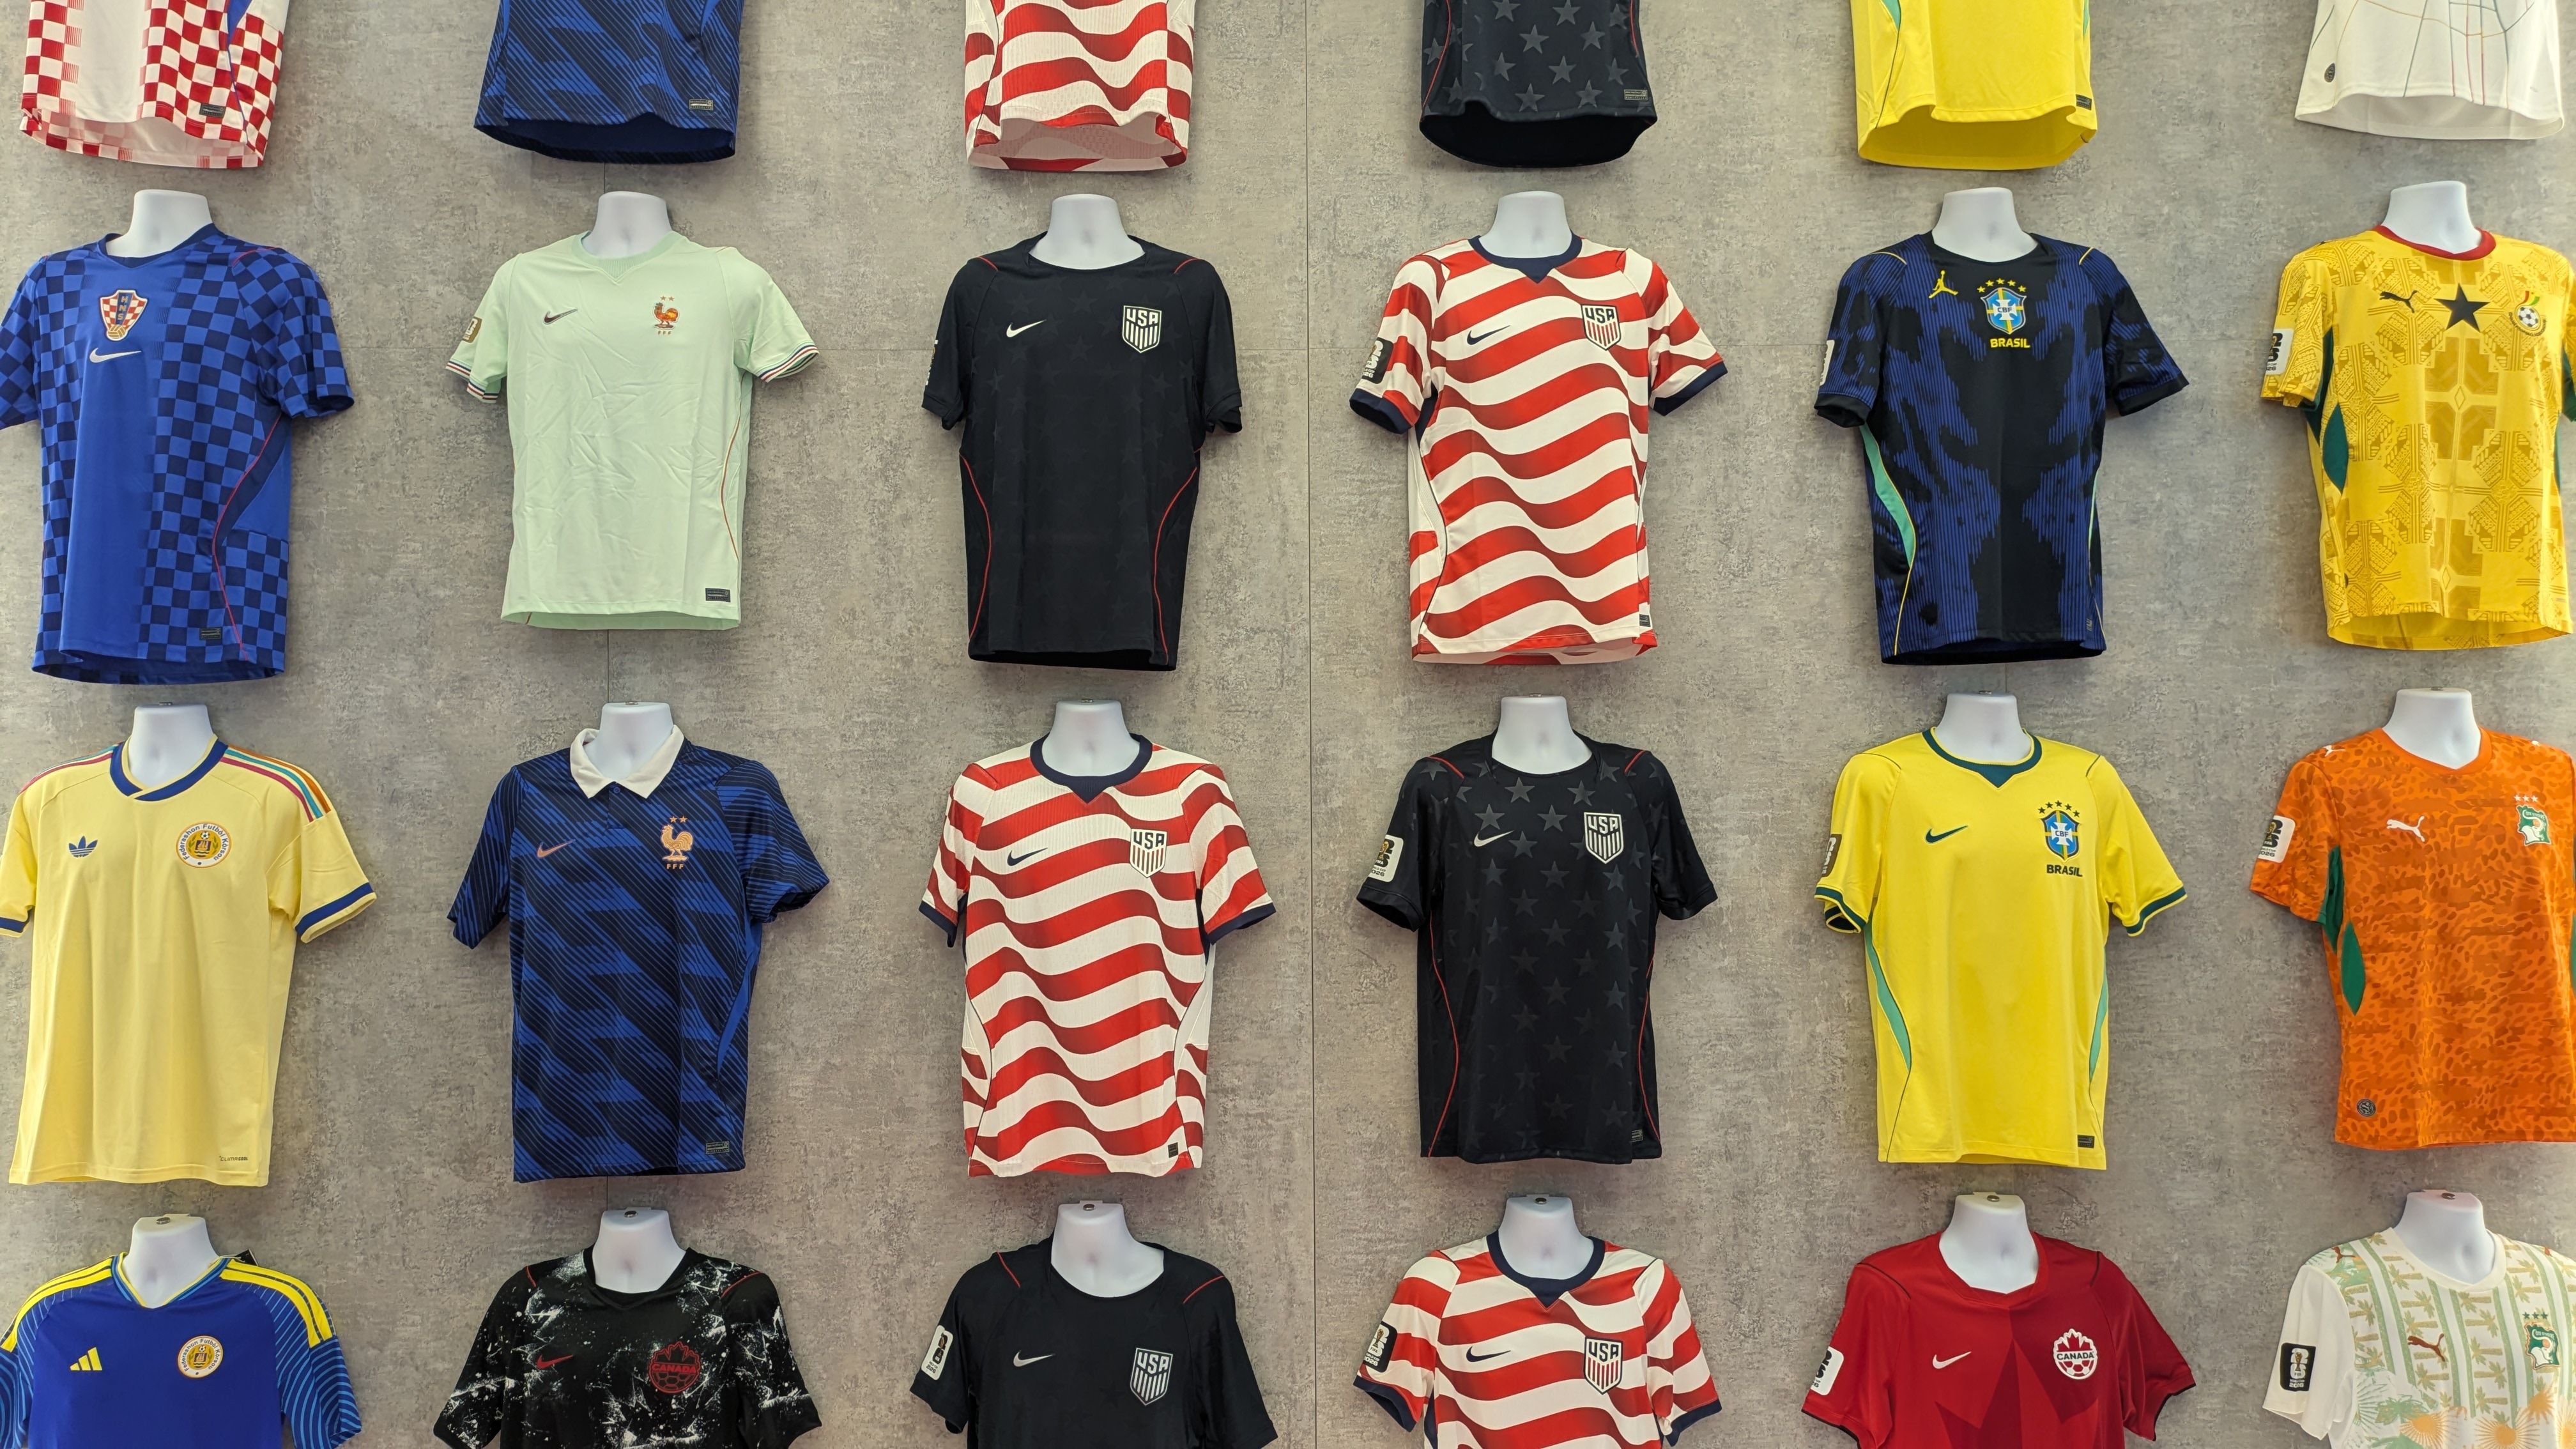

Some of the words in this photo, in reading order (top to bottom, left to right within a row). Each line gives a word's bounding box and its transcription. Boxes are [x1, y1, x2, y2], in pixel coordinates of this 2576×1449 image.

[118, 296, 128, 320] HNS
[1585, 307, 1614, 323] USA
[1126, 309, 1158, 326] USA
[1990, 338, 2031, 348] BRASIL
[1588, 816, 1618, 834] USA
[179, 825, 200, 860] Federashon
[1133, 831, 1165, 850] USA
[2046, 864, 2083, 877] BRASIL
[181, 1340, 198, 1372] Federashon
[1589, 1342, 1619, 1362] USA
[2057, 1352, 2094, 1360] CANADA
[652, 1363, 696, 1373] CANADA
[1137, 1352, 1169, 1374] USA
